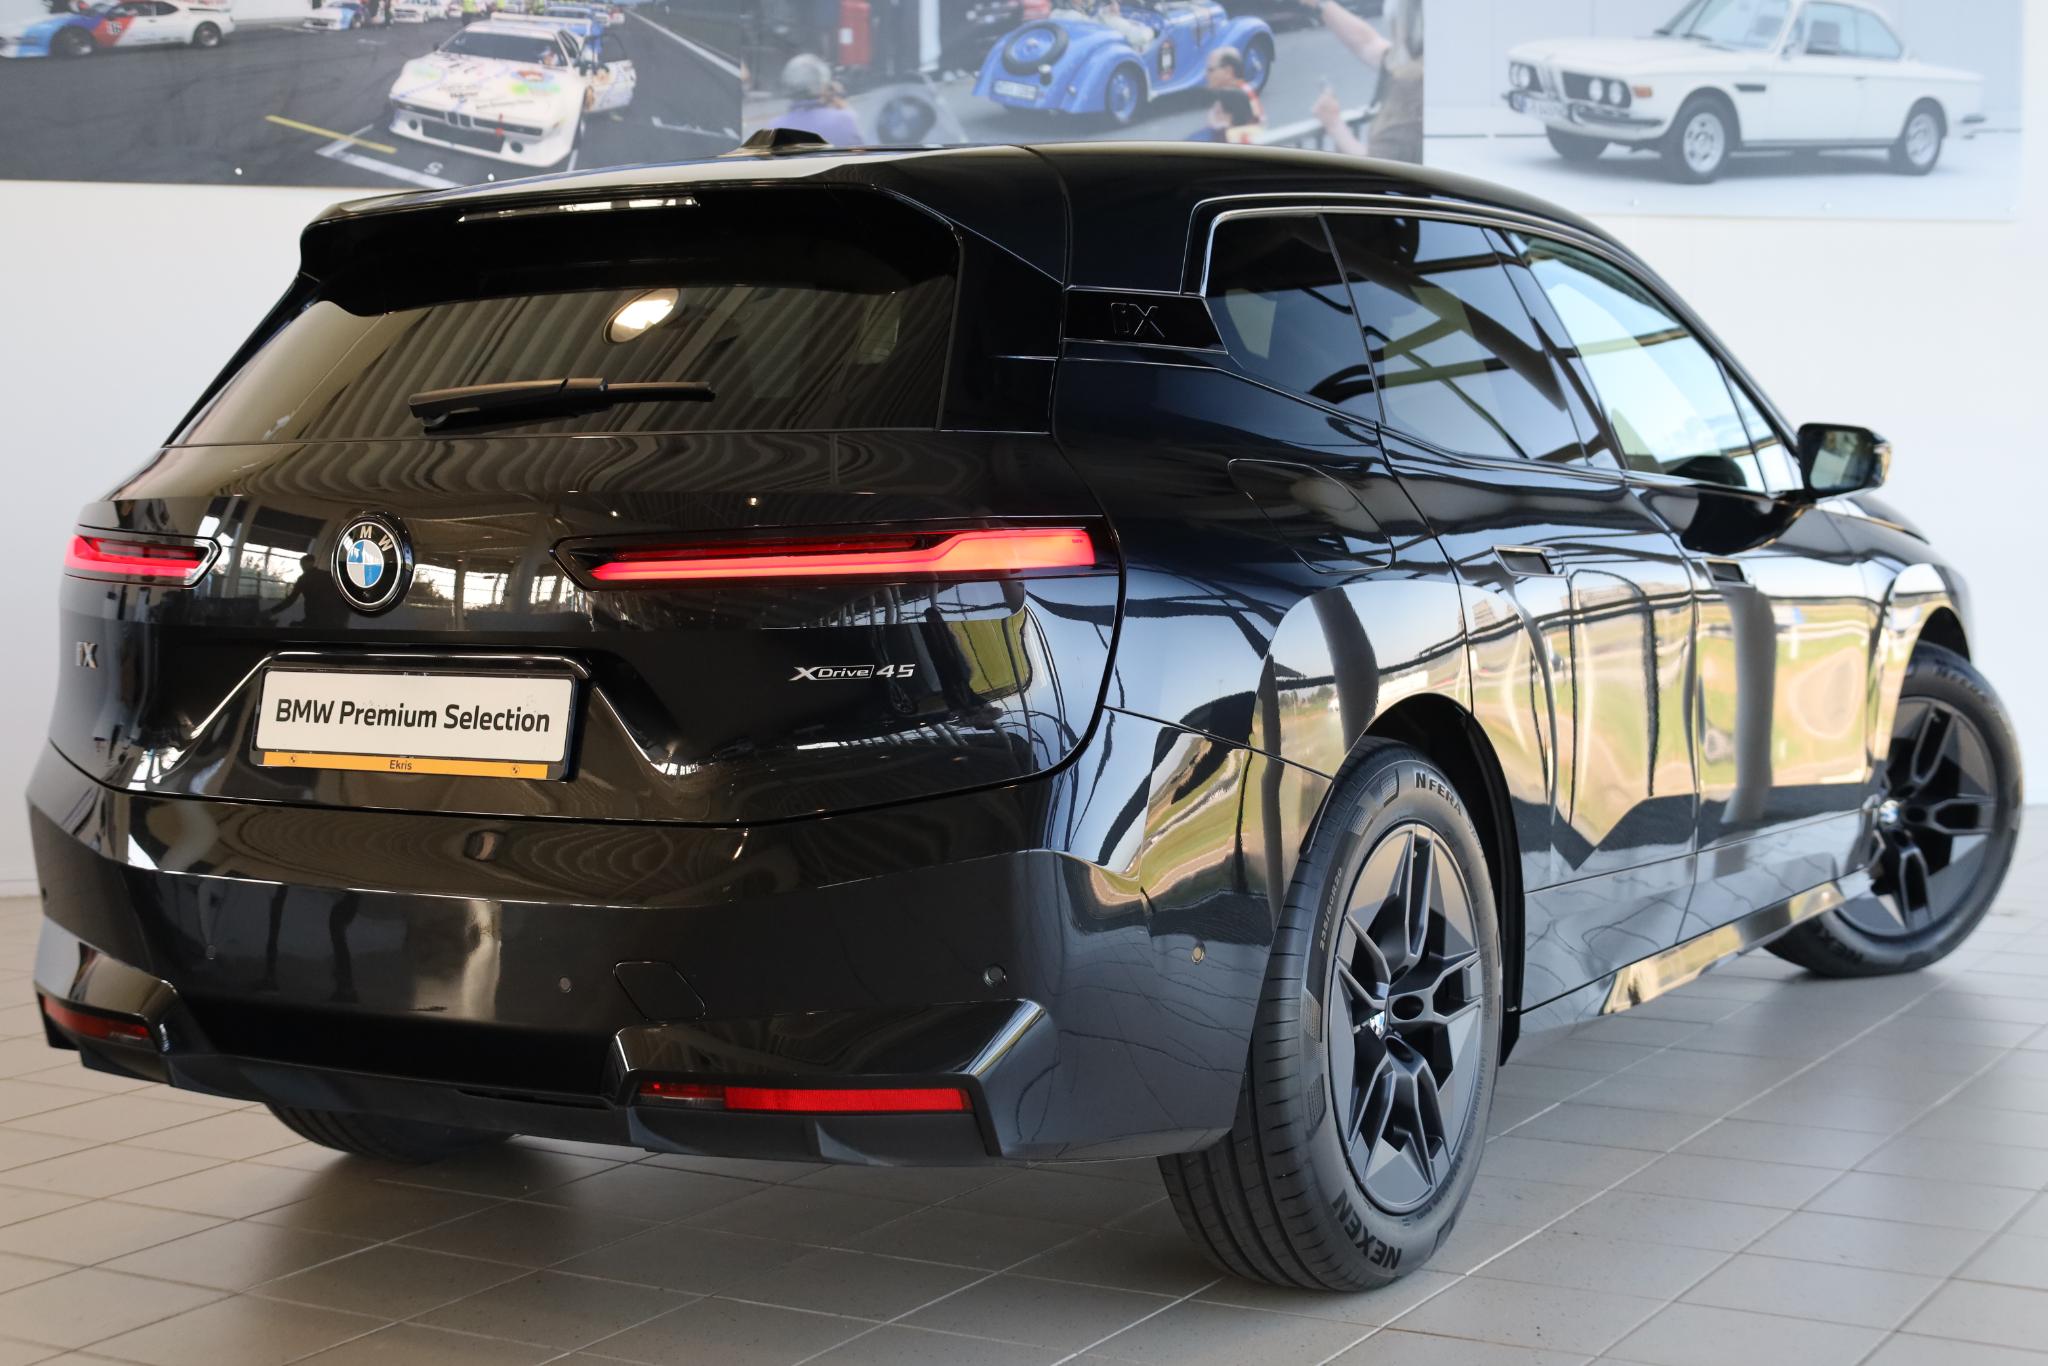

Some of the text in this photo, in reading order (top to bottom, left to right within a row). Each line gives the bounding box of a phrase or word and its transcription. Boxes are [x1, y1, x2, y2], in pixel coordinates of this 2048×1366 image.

[876, 664, 916, 678] 45
[275, 698, 550, 733] BMW Premium Selection
[389, 759, 413, 771] Ekris
[1415, 772, 1462, 816] N FERA
[1332, 1188, 1402, 1270] NEXEN
